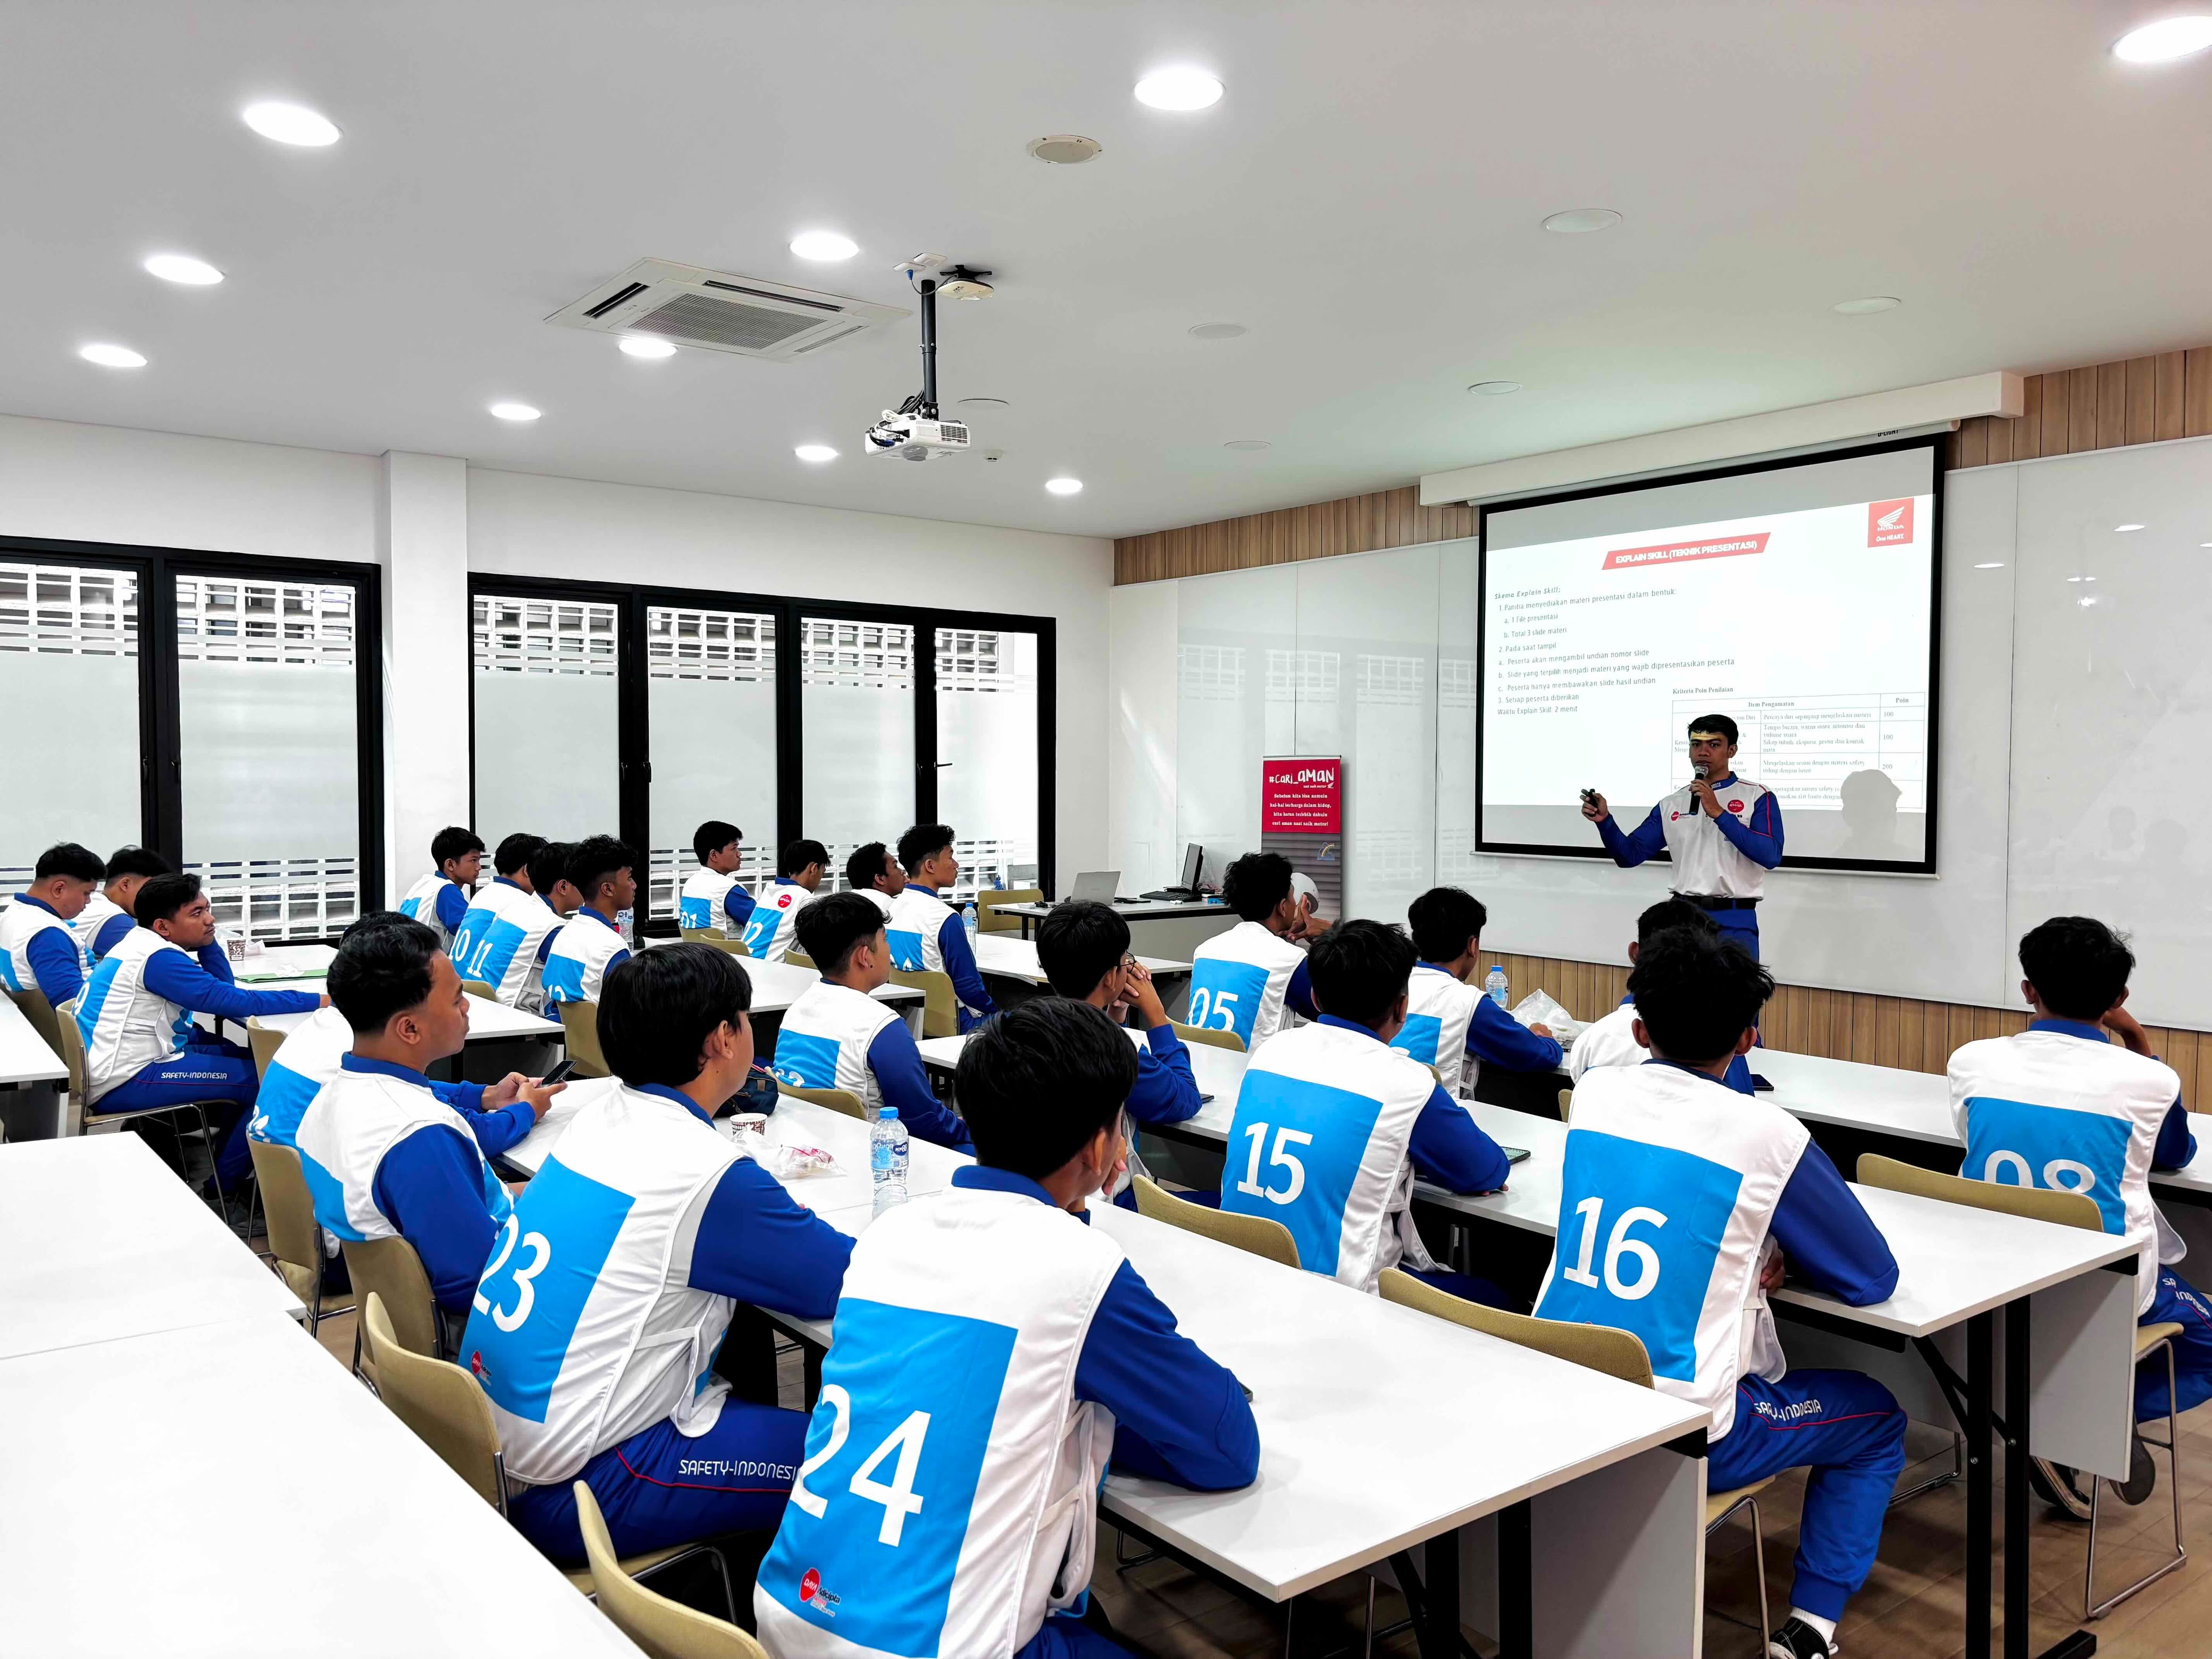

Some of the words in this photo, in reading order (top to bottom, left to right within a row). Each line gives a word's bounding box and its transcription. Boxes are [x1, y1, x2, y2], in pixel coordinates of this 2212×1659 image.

[1615, 553, 1646, 564] EXPLAIN
[1647, 550, 1669, 560] SKILL
[1669, 547, 1701, 559] (TEKNIK
[1702, 540, 1757, 554] PRESENTASI)
[1526, 599, 1568, 609] menyediakan
[1592, 593, 1625, 603] presentasi
[1652, 588, 1677, 597] bentuk:
[1527, 613, 1558, 623] presentasi
[1540, 668, 1561, 676] terpilih
[1651, 660, 1705, 669] dipresentasikan
[1707, 659, 1734, 667] peserta
[1549, 653, 1585, 662] mengambil
[1531, 683, 1549, 691] hanya
[1552, 680, 1597, 689] membawakan
[448, 928, 471, 962] 10
[467, 939, 493, 978] 11
[1188, 987, 1239, 1032] 05
[1237, 1122, 1313, 1204] 15
[1563, 1196, 1669, 1301] 16
[472, 1214, 551, 1333] 23
[678, 1459, 797, 1481] SAFETY-INDONESI
[790, 1384, 931, 1548] 24
[804, 1578, 818, 1591] DAYA
[817, 1587, 840, 1604] Adicipta
